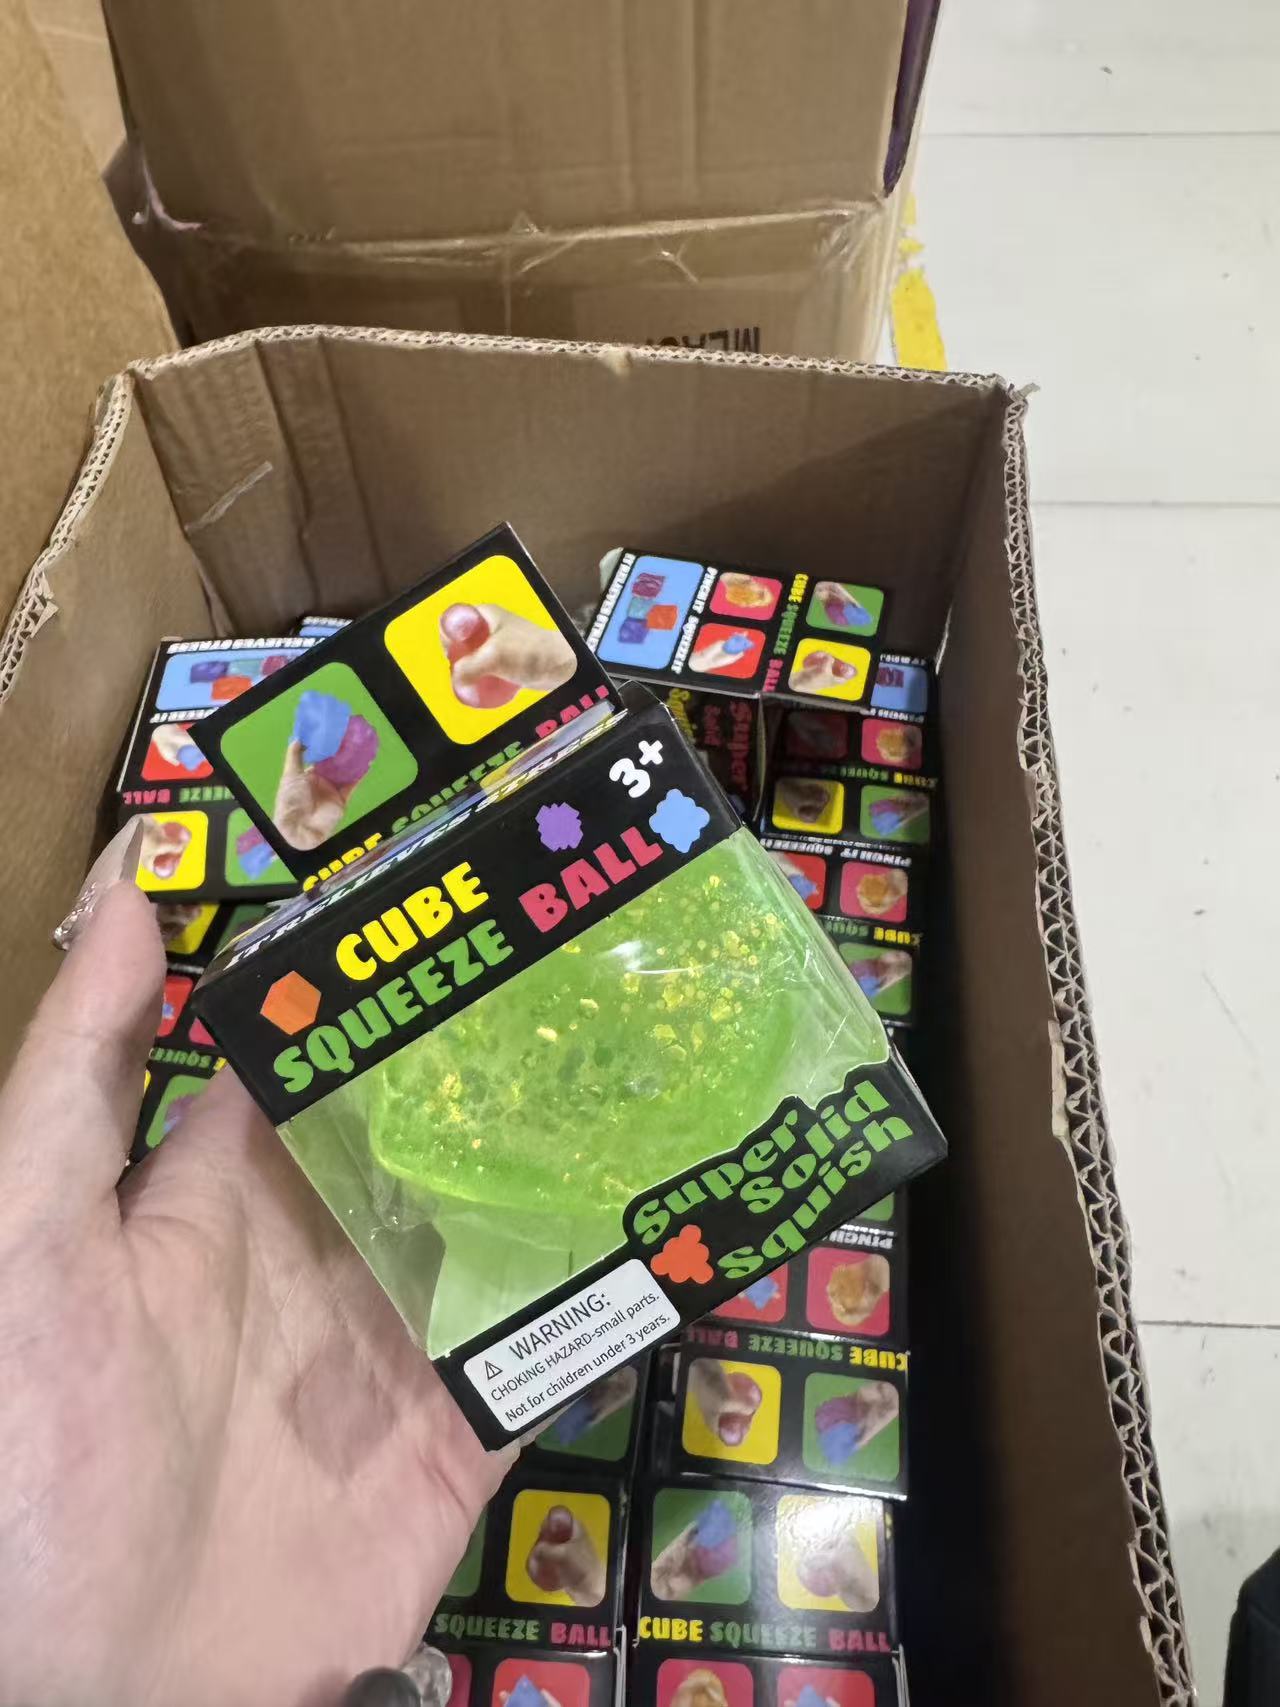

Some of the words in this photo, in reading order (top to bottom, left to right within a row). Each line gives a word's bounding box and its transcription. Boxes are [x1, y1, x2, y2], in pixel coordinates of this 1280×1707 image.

[788, 573, 809, 603] CUBE
[122, 789, 171, 805] BALL
[608, 739, 664, 799] 3+
[272, 919, 516, 1094] SQUEEZE
[518, 826, 664, 933] BALL
[335, 862, 490, 982] CUBE
[633, 1109, 799, 1245] Super
[740, 1080, 890, 1213] Solid
[717, 1117, 913, 1279] Squish
[490, 1361, 546, 1401] CHOKING
[546, 1309, 627, 1368] HAZARD-small
[627, 1292, 660, 1320] parts.
[505, 1403, 529, 1423] Not
[529, 1391, 546, 1409] for
[546, 1361, 594, 1398] children
[593, 1340, 627, 1368] under
[626, 1332, 637, 1345] 3
[636, 1316, 671, 1342] years.
[509, 1293, 612, 1361] WARNING:
[748, 1333, 843, 1362] SQUEEZE
[849, 1345, 908, 1371] CUBE
[434, 1613, 540, 1642] SQUEEZE
[550, 1622, 612, 1648] BALL
[638, 1616, 704, 1642] CUBE
[710, 1621, 818, 1648] SQUEEZE
[828, 1628, 892, 1654] BALL
